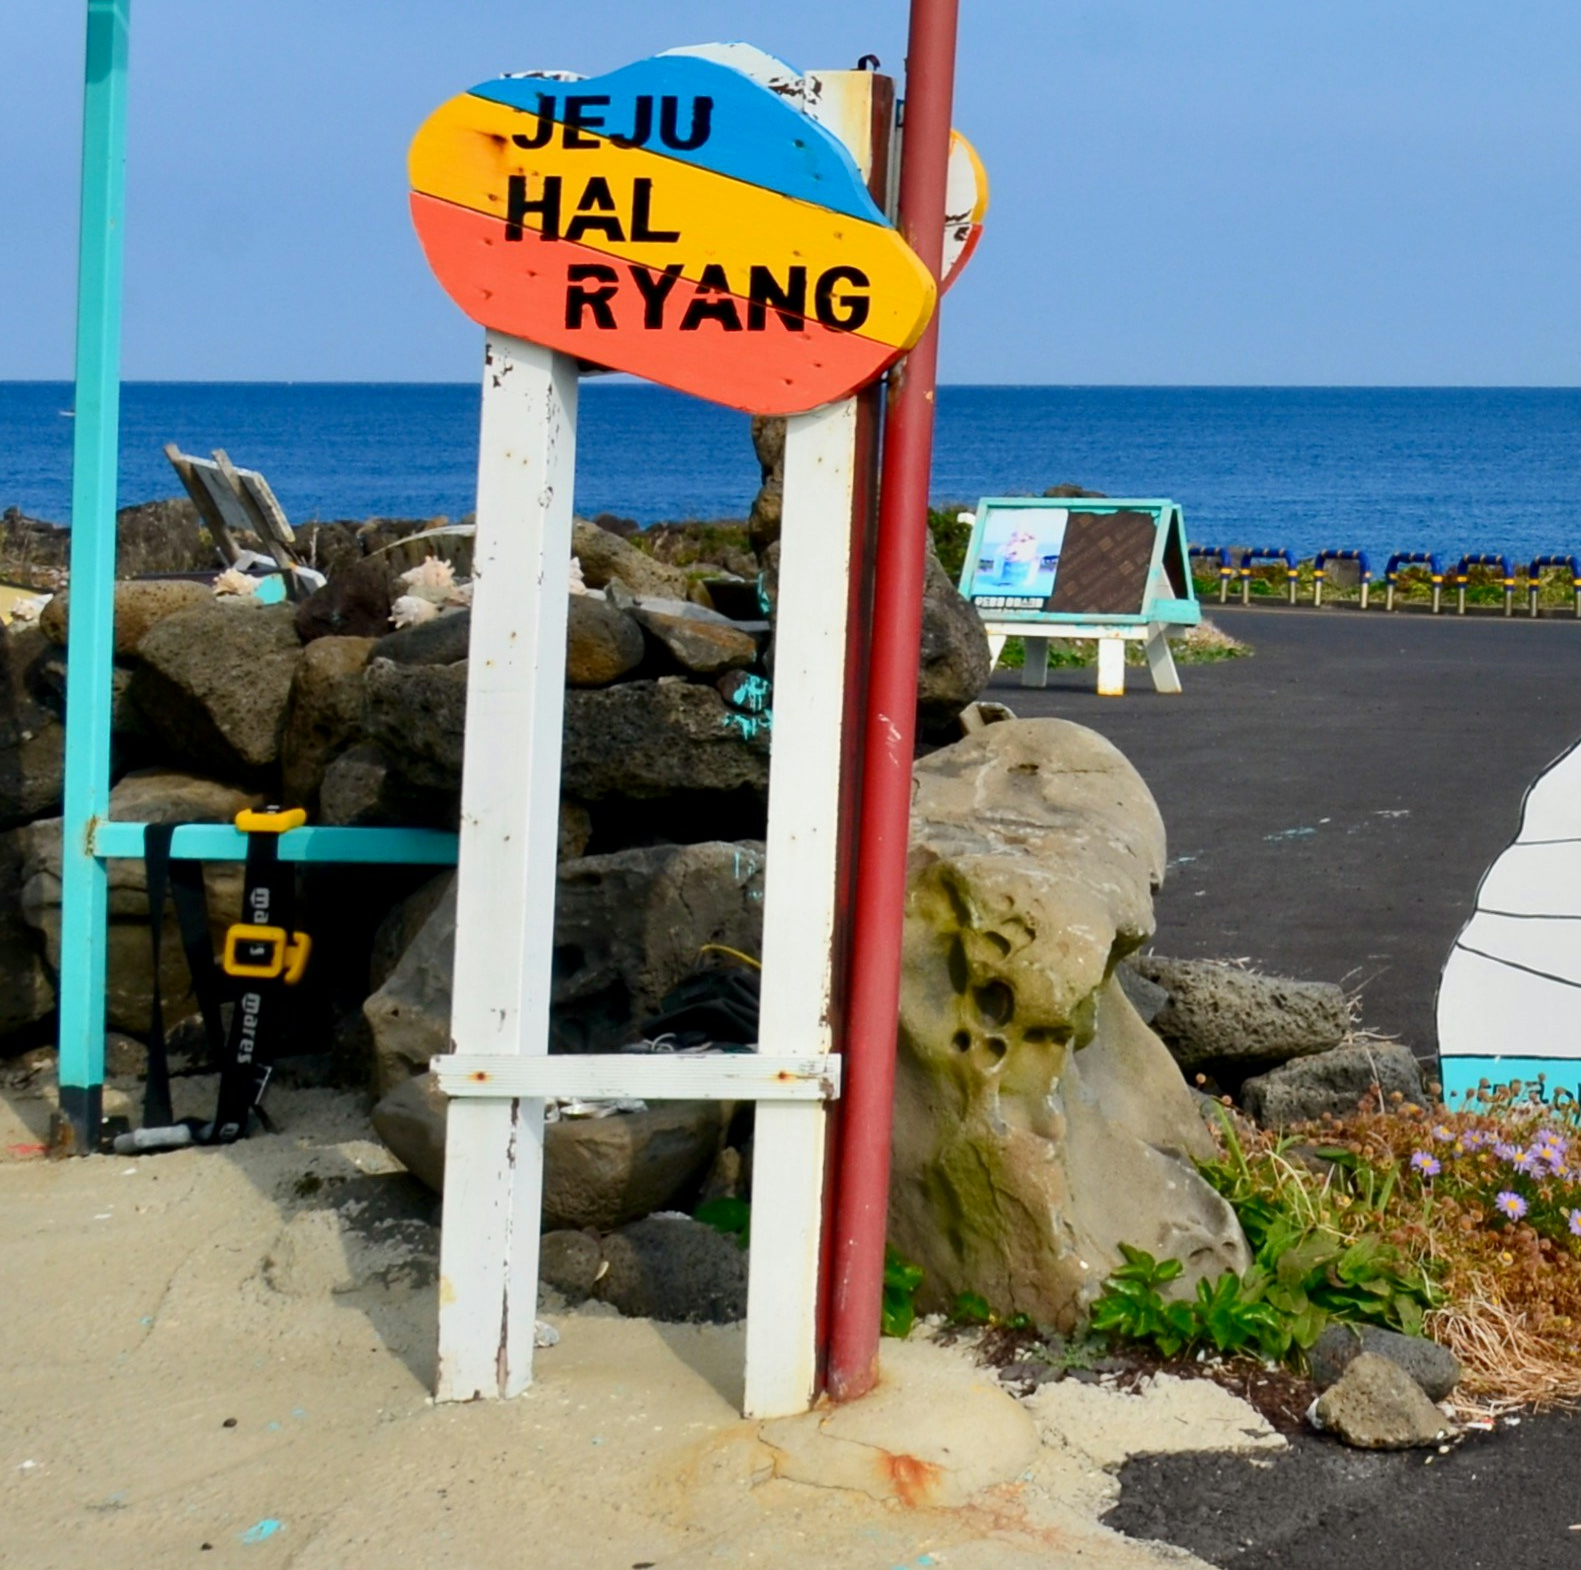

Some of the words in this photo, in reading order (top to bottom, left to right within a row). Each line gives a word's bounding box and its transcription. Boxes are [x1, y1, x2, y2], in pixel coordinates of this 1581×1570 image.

[512, 95, 713, 150] JEJU
[505, 175, 680, 242] HAL
[565, 265, 870, 331] RYANG
[250, 887, 270, 956] mas
[237, 992, 261, 1064] mares
